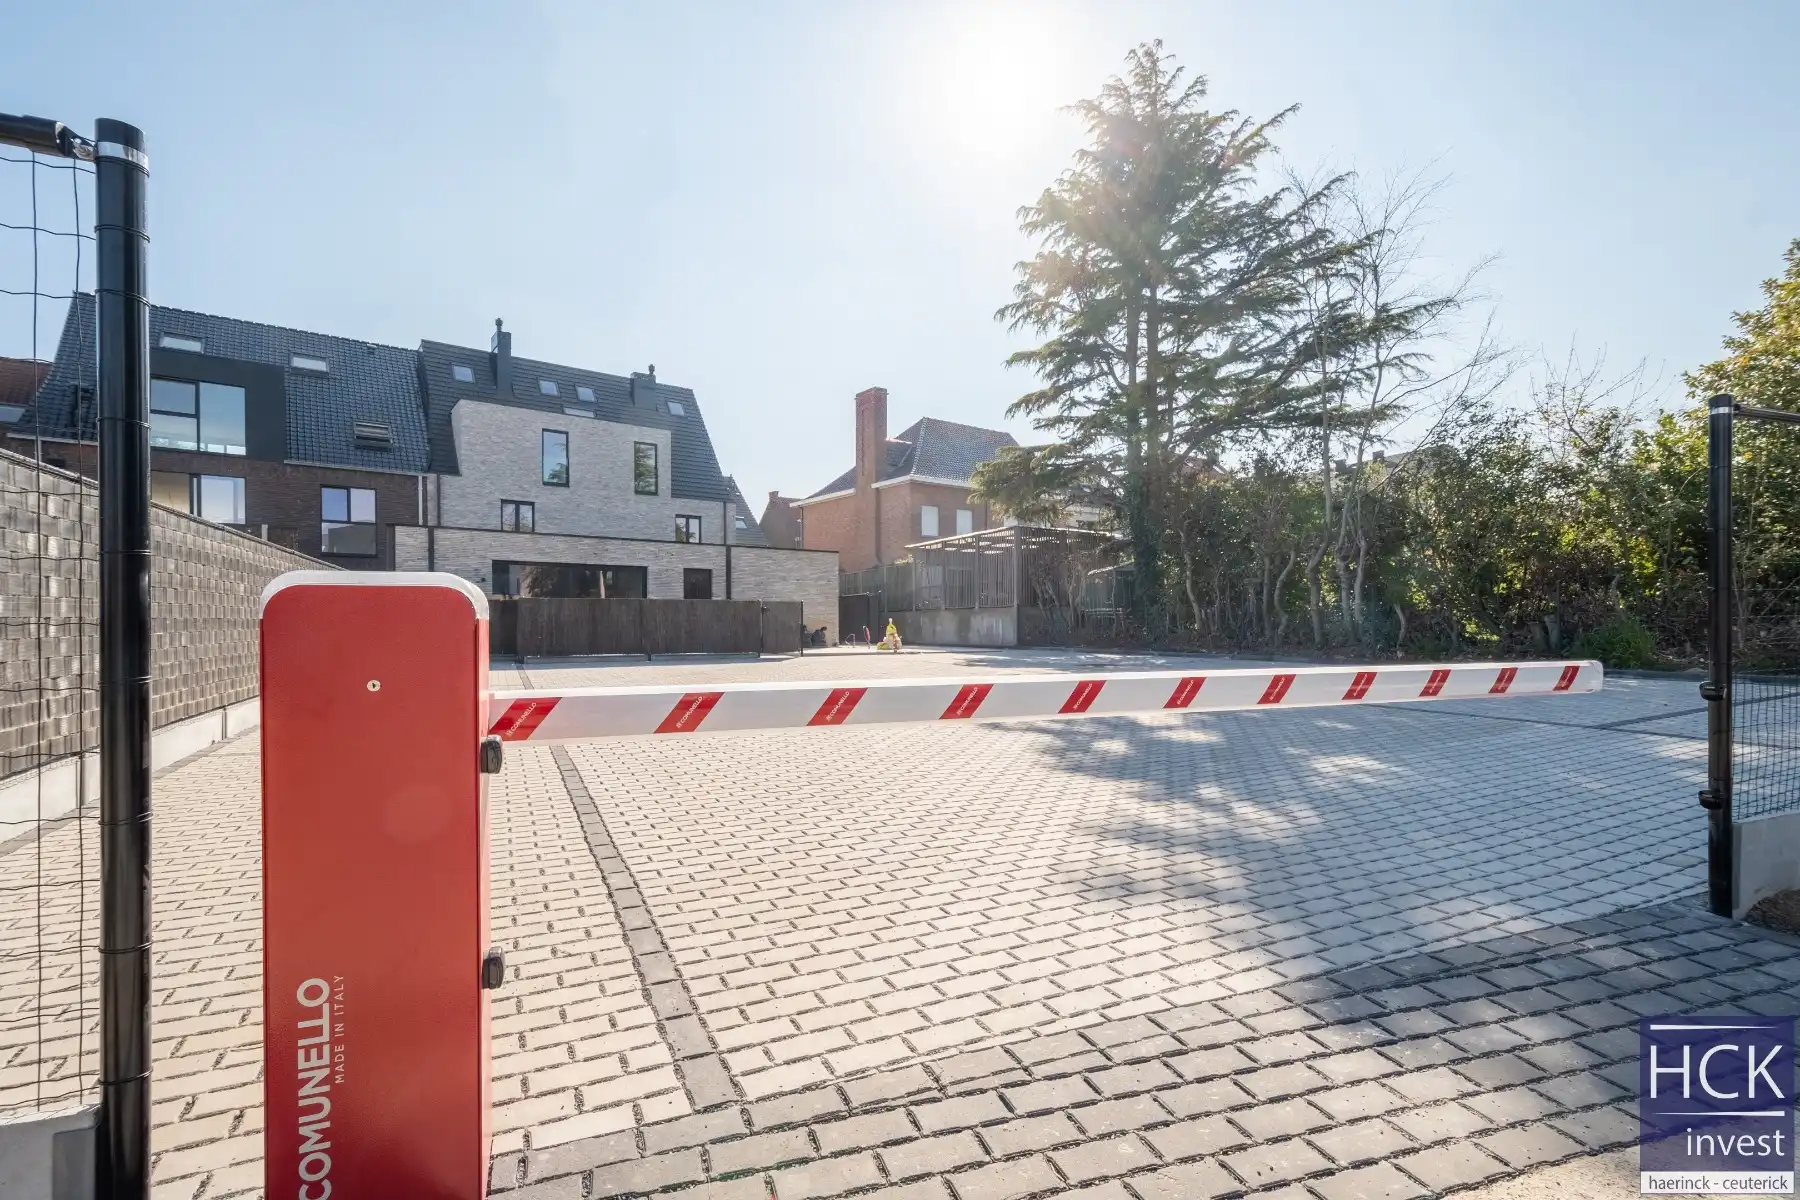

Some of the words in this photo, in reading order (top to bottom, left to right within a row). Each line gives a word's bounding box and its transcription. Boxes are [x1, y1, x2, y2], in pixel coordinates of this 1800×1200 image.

[680, 696, 703, 725] COMUNELLO
[829, 691, 850, 716] COMUNELLO
[960, 686, 978, 712] COMUNELLO
[510, 702, 537, 732] COMUNELLO
[333, 975, 344, 1016] ITALY
[335, 1023, 345, 1038] IN
[335, 1044, 345, 1084] MADE
[296, 977, 332, 1200] COMUNELLO
